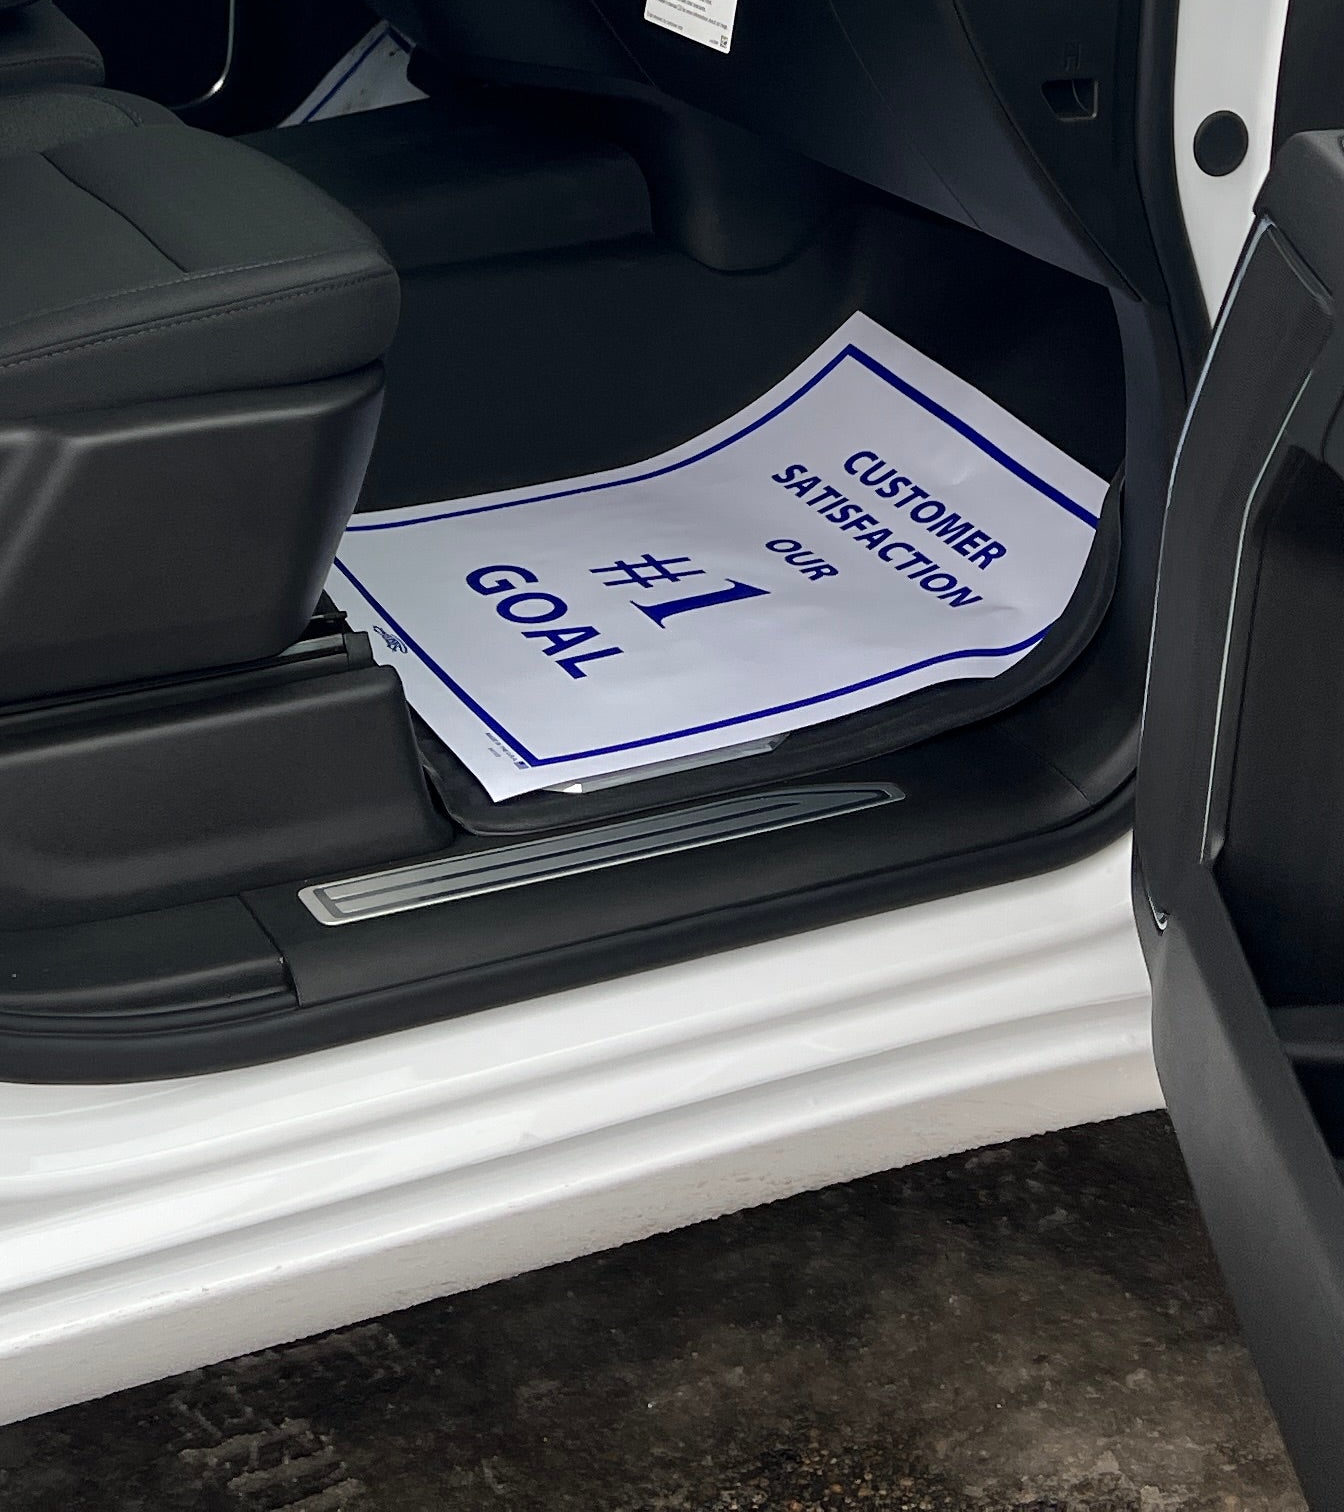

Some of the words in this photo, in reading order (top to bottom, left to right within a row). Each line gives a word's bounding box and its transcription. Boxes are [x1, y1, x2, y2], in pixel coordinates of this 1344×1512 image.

[765, 537, 839, 581] OUR
[772, 464, 983, 608] SATISFACTION
[843, 450, 1007, 569] CUSTOMER
[465, 563, 626, 680] GOAL
[589, 553, 770, 629] #1
